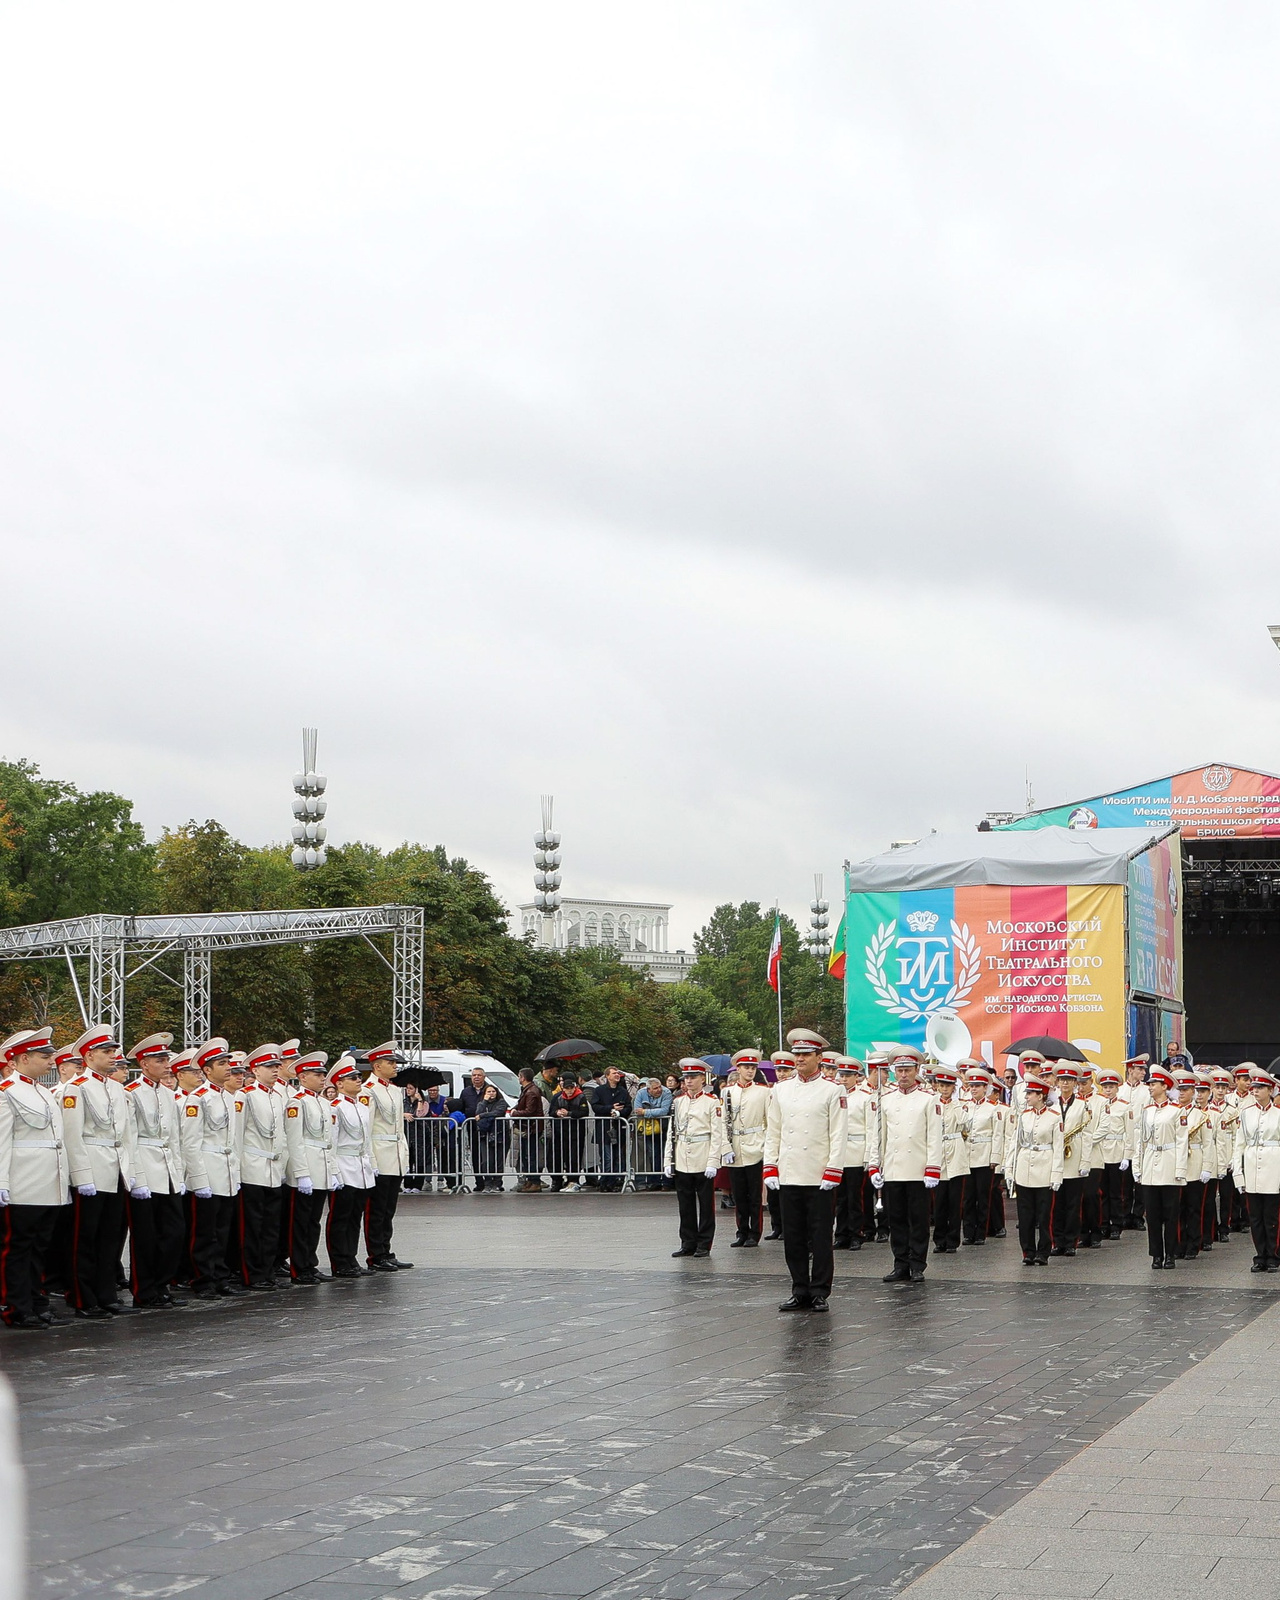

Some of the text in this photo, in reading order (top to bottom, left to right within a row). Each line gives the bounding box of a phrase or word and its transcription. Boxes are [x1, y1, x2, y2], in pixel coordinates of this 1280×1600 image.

[1102, 796, 1151, 805] МосИТИ
[1173, 796, 1185, 804] И.
[1186, 795, 1198, 805] Д.
[1200, 794, 1249, 803] Кобзона
[1133, 806, 1233, 817] Международный
[1144, 817, 1219, 827] театральных
[1221, 816, 1252, 825] школ
[1196, 827, 1236, 837] БРИКС
[985, 1004, 1014, 1014] СССР
